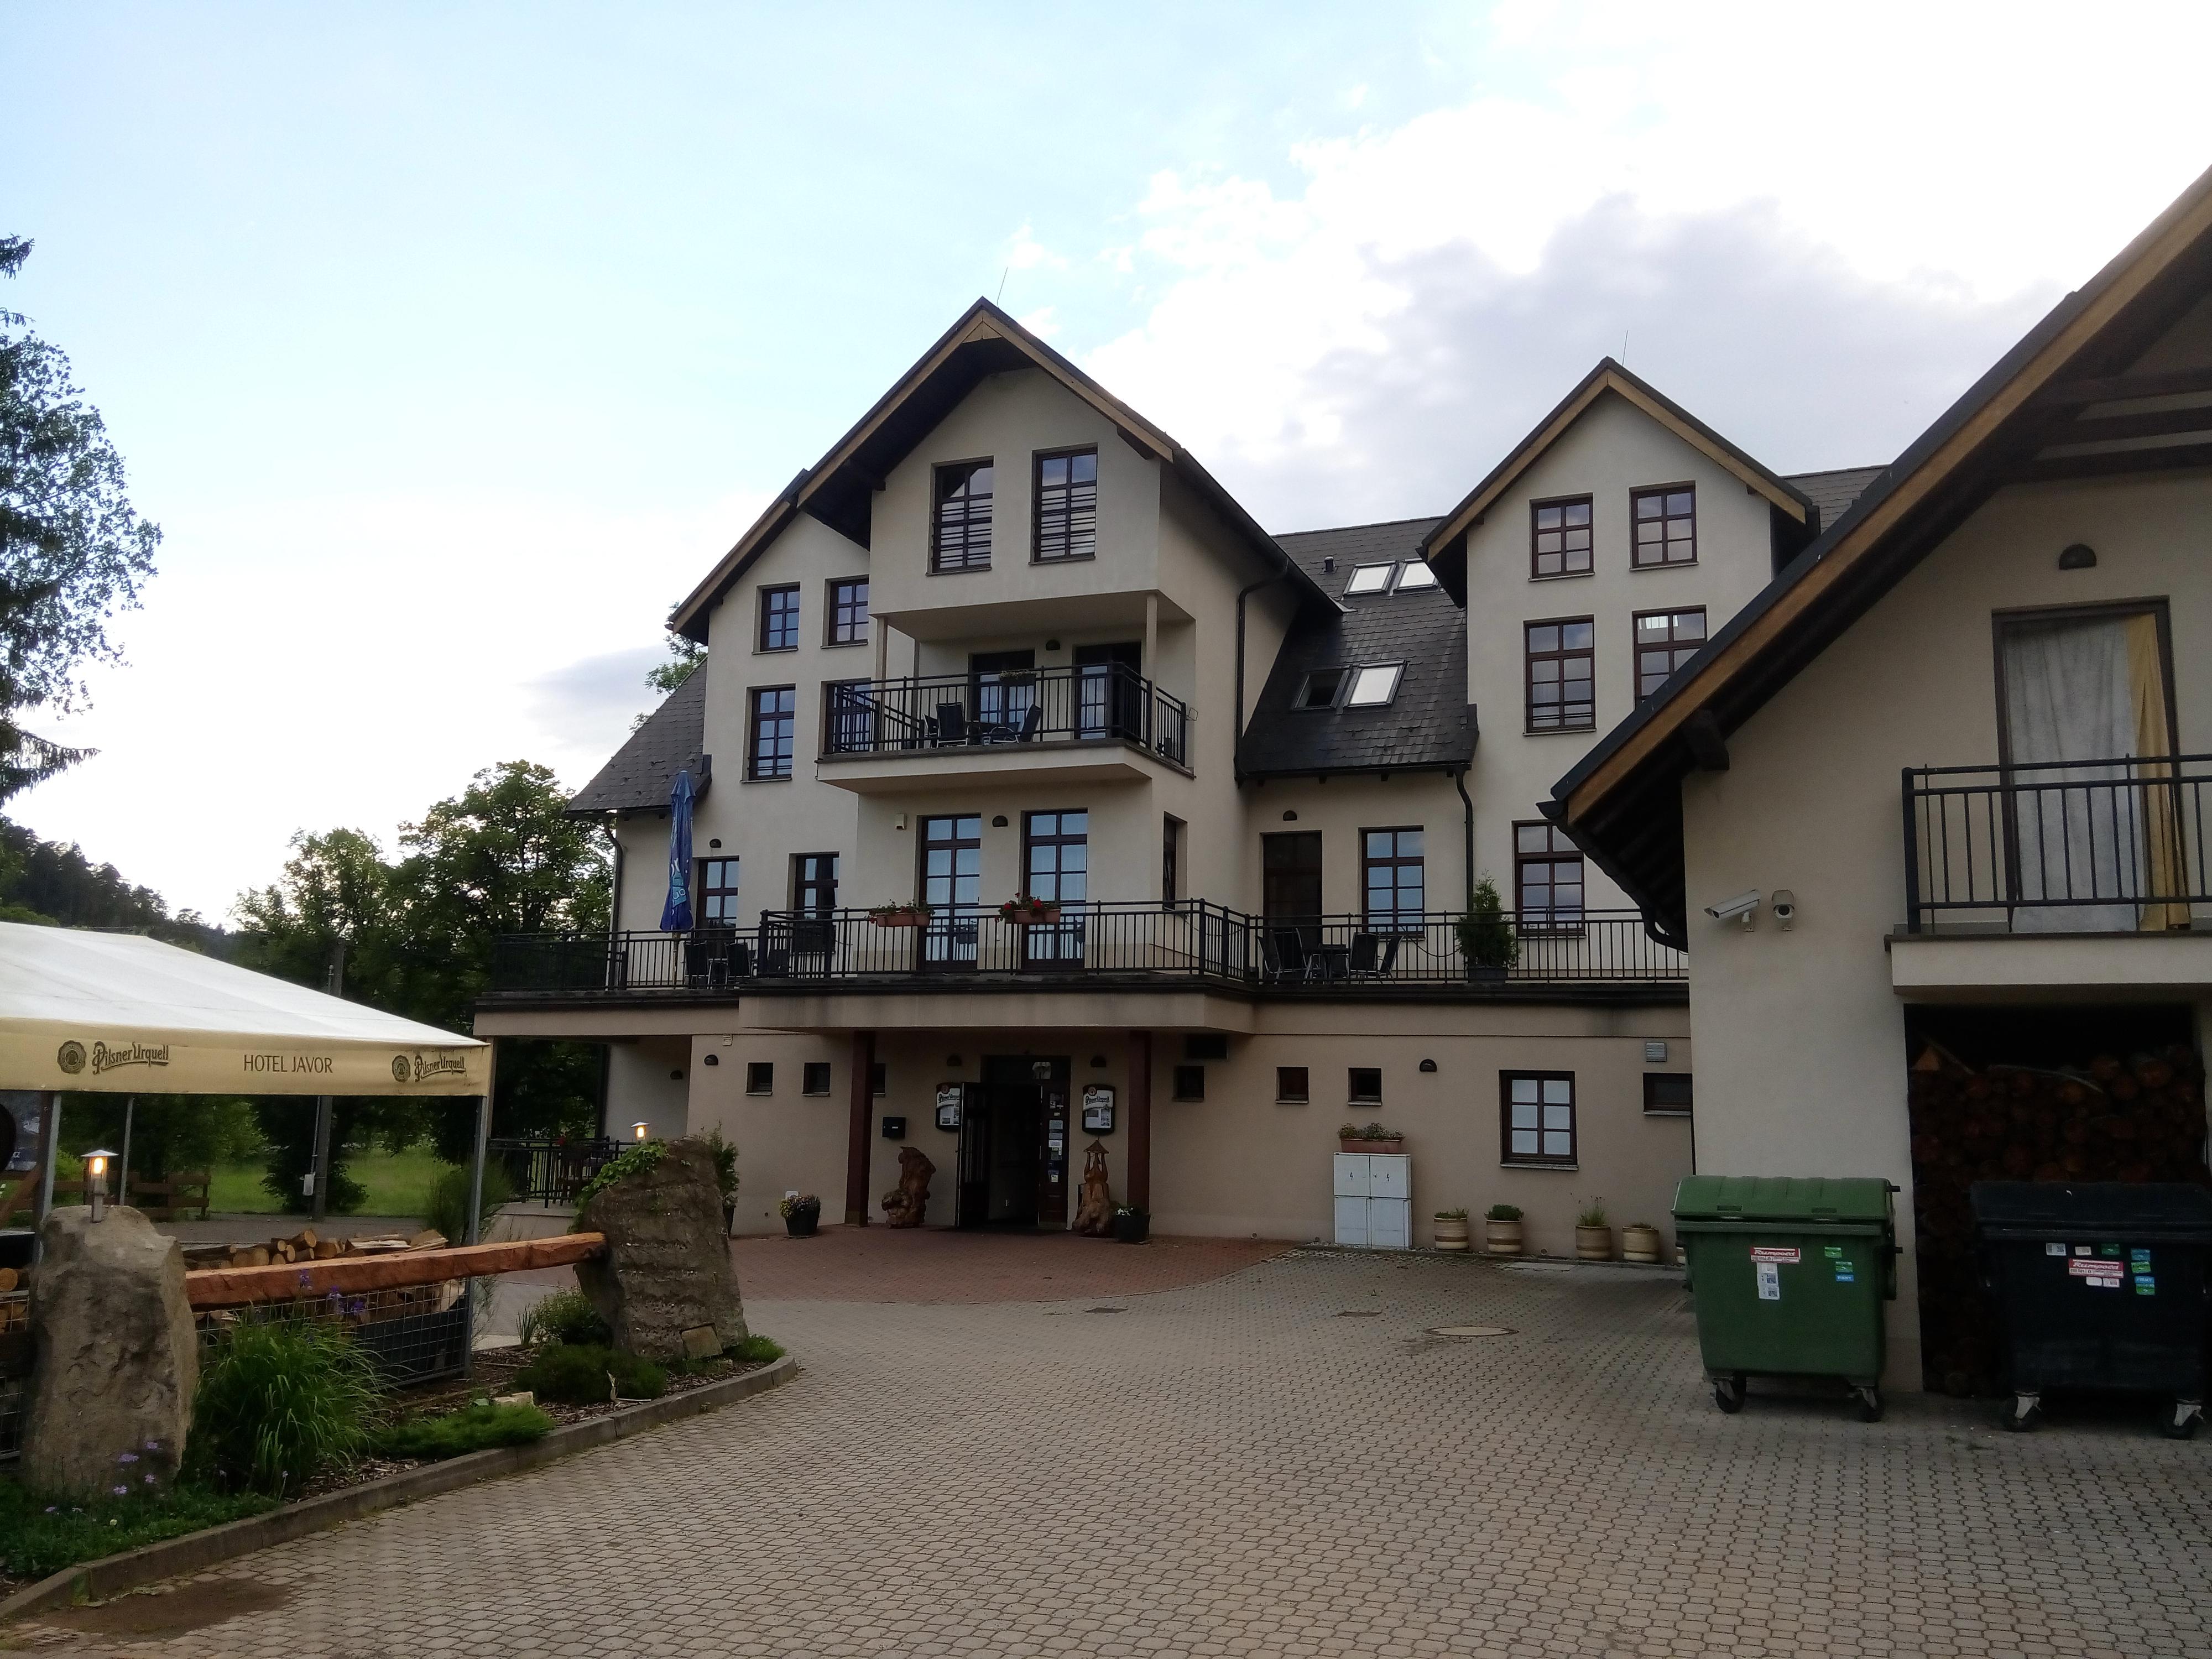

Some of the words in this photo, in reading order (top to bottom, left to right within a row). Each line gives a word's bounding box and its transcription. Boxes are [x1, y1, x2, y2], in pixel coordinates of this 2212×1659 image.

[92, 1041, 133, 1075] Pilsner
[132, 1042, 169, 1067] Urquell
[244, 1055, 288, 1072] HOTEL
[292, 1056, 333, 1073] JAVOR
[415, 1055, 440, 1082] Pilsner
[440, 1052, 465, 1074] Urquell
